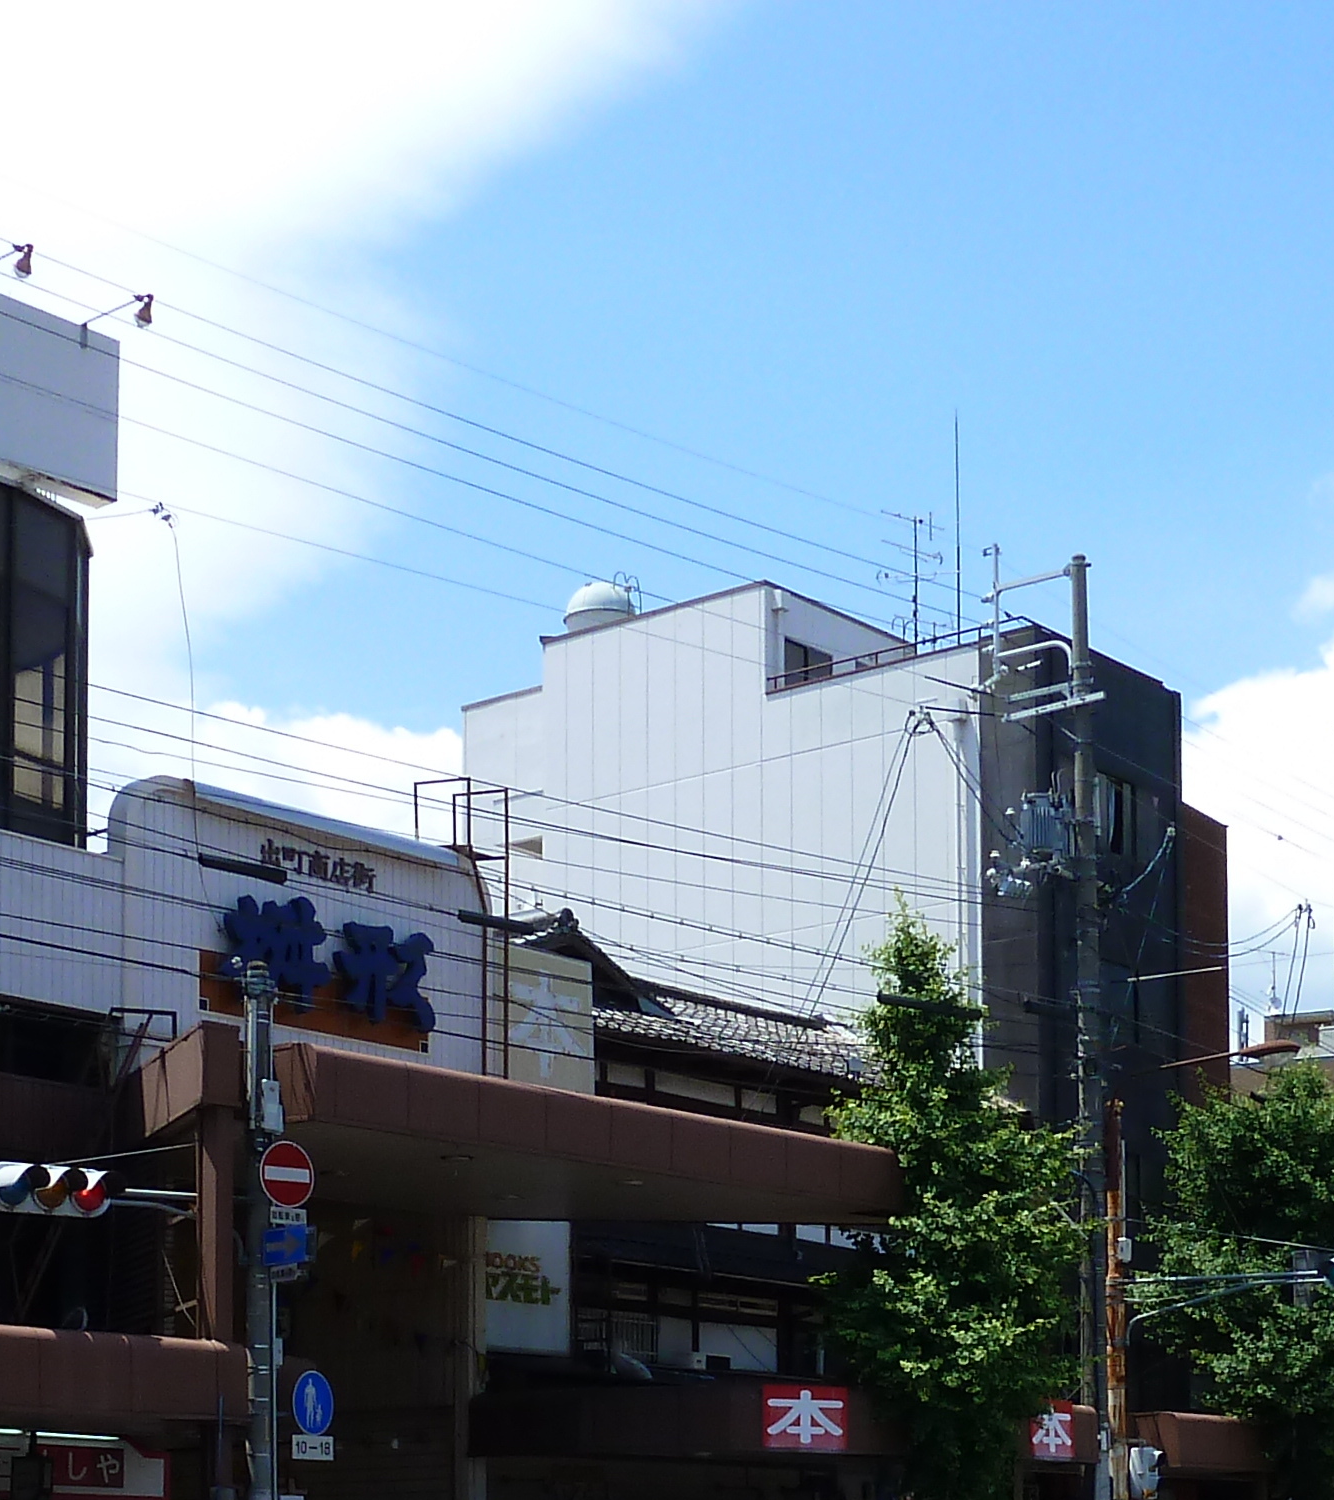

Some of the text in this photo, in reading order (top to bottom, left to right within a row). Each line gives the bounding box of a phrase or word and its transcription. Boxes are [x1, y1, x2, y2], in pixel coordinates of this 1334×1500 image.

[509, 969, 586, 1078] 本
[767, 1389, 845, 1445] 本
[1031, 1410, 1073, 1454] 本
[41, 1448, 121, 1485] しや
